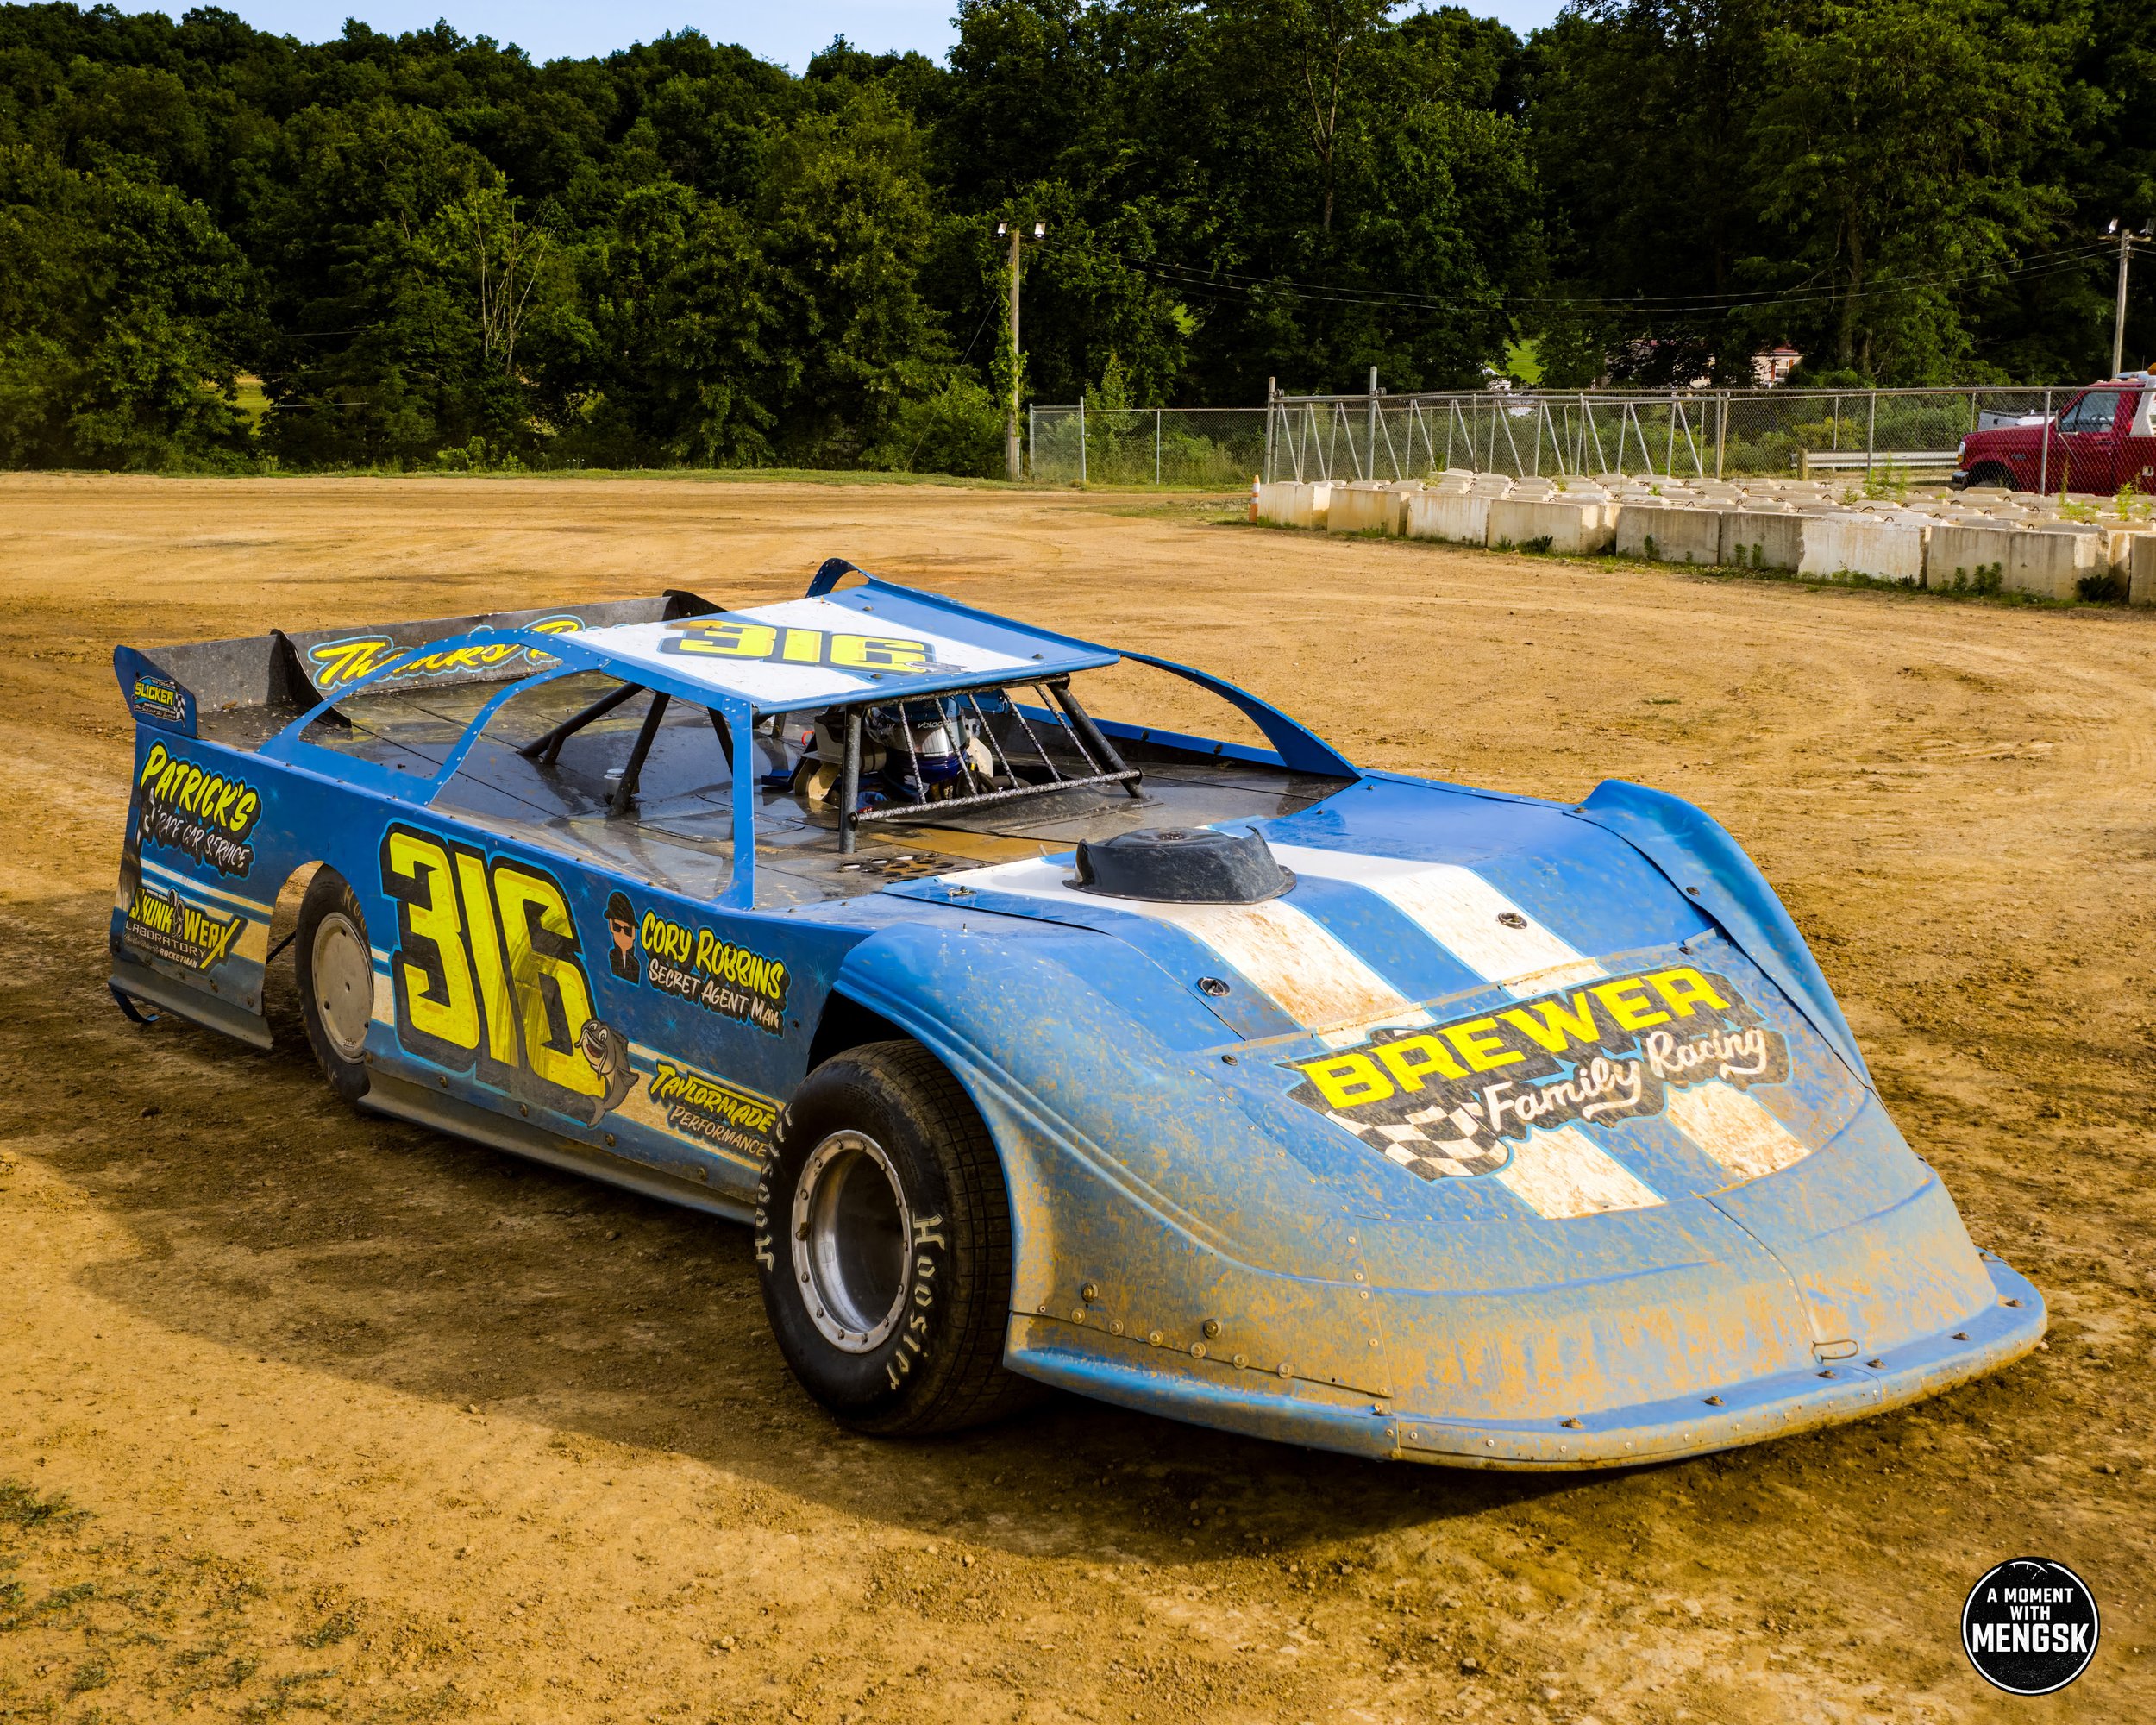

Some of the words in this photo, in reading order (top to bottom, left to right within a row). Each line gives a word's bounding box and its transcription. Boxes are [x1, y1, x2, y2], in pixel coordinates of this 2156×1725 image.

[673, 620, 927, 674] 316
[135, 681, 174, 706] SLICKER
[141, 744, 257, 831] PATRICK'S
[125, 919, 207, 958] LABORATORY
[128, 887, 174, 934] SKUNK
[160, 948, 198, 969] ROCKETMAN
[390, 831, 605, 1101] 316
[642, 912, 692, 963] CORY
[696, 930, 784, 999] ROBBINS
[649, 957, 701, 996] SECRET
[701, 980, 749, 1014] AGENT
[1297, 967, 1731, 1110] BREWER
[650, 1063, 776, 1133] TAYLORMADE
[1482, 1057, 1642, 1131] Family
[1645, 1027, 1767, 1080] Racing
[670, 1105, 768, 1157] PERFORMANCE
[886, 1210, 946, 1391] Hoosier
